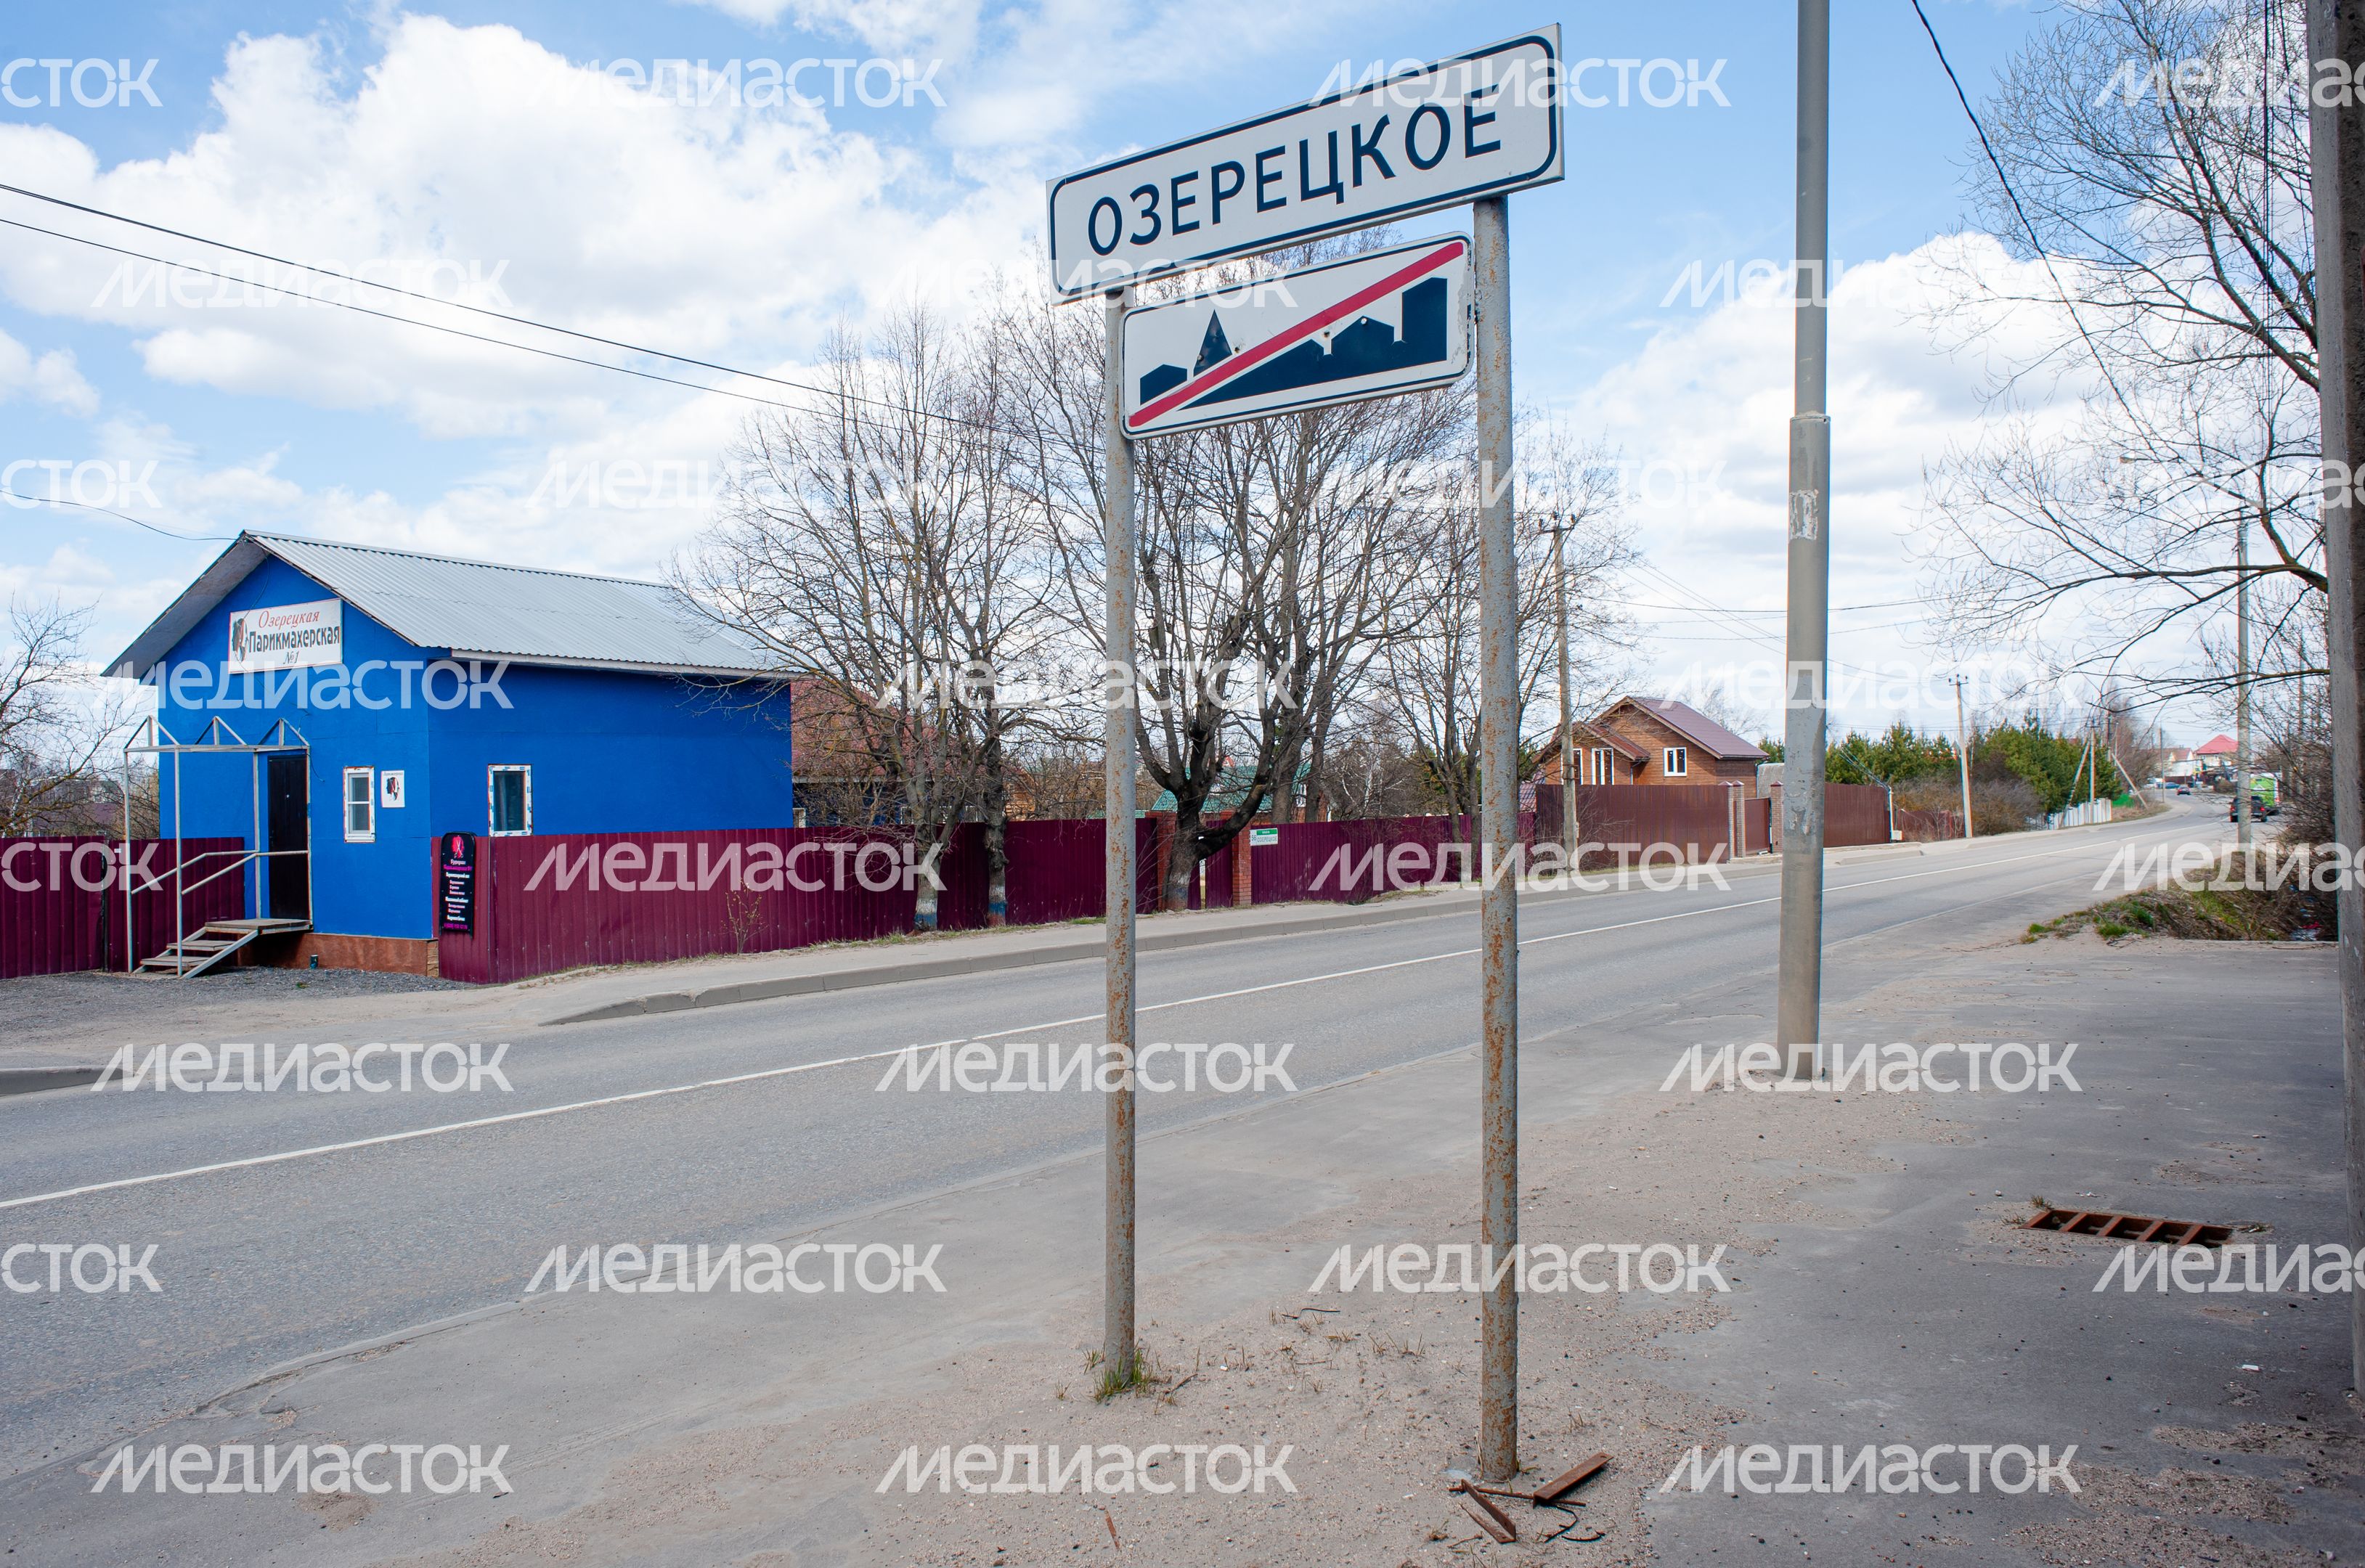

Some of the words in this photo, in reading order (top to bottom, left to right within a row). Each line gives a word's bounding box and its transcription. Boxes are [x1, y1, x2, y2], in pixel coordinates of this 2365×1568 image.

[1088, 83, 1502, 256] ОЗЕРЕЦКОЕ
[259, 610, 320, 631] Озерецкая
[248, 625, 340, 653] Парикмахерская
[282, 650, 300, 665] №1
